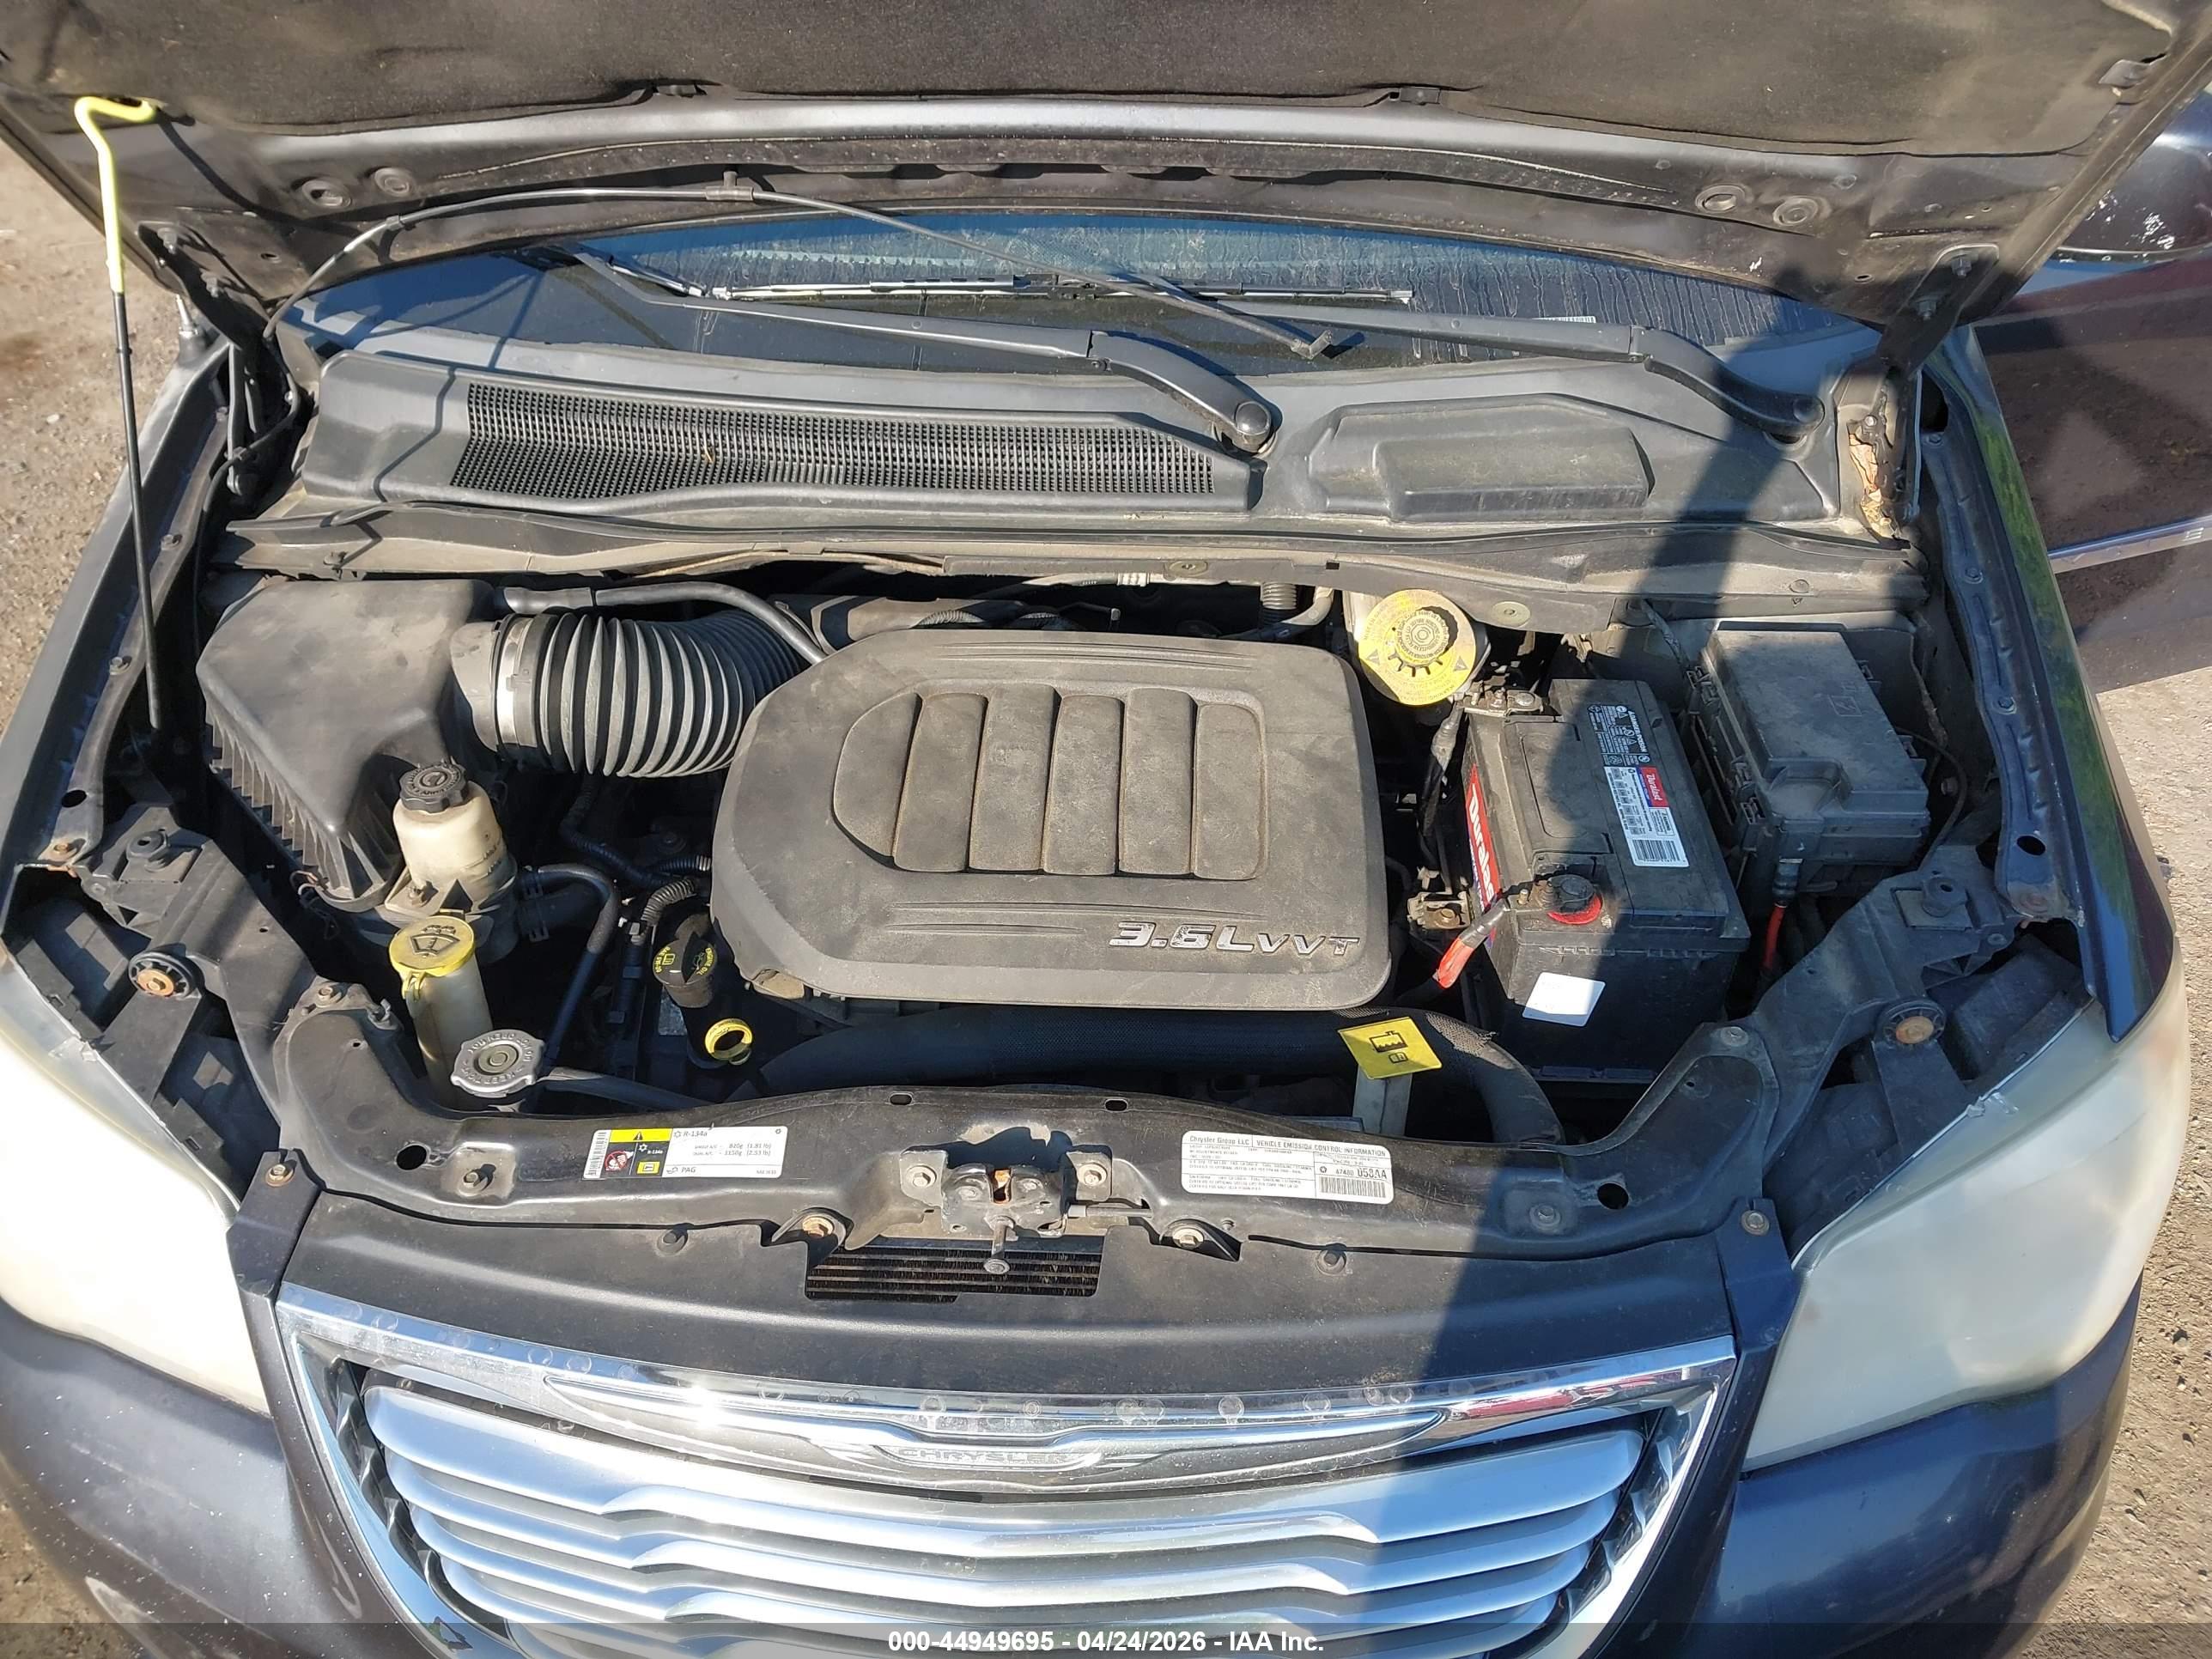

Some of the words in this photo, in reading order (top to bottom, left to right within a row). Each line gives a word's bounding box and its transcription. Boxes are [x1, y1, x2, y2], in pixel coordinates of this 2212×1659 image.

[1646, 774, 1662, 800] Duralast
[1257, 933, 1360, 955] VVT
[705, 947, 714, 967] ENGINE
[696, 966, 708, 975] OIL
[1217, 1137, 1236, 1146] Group
[1256, 1139, 1282, 1148] VEHICLE
[1283, 1142, 1313, 1151] EMISSION
[1314, 1144, 1343, 1153] CONTROL
[1344, 1148, 1386, 1157] INFORMATION
